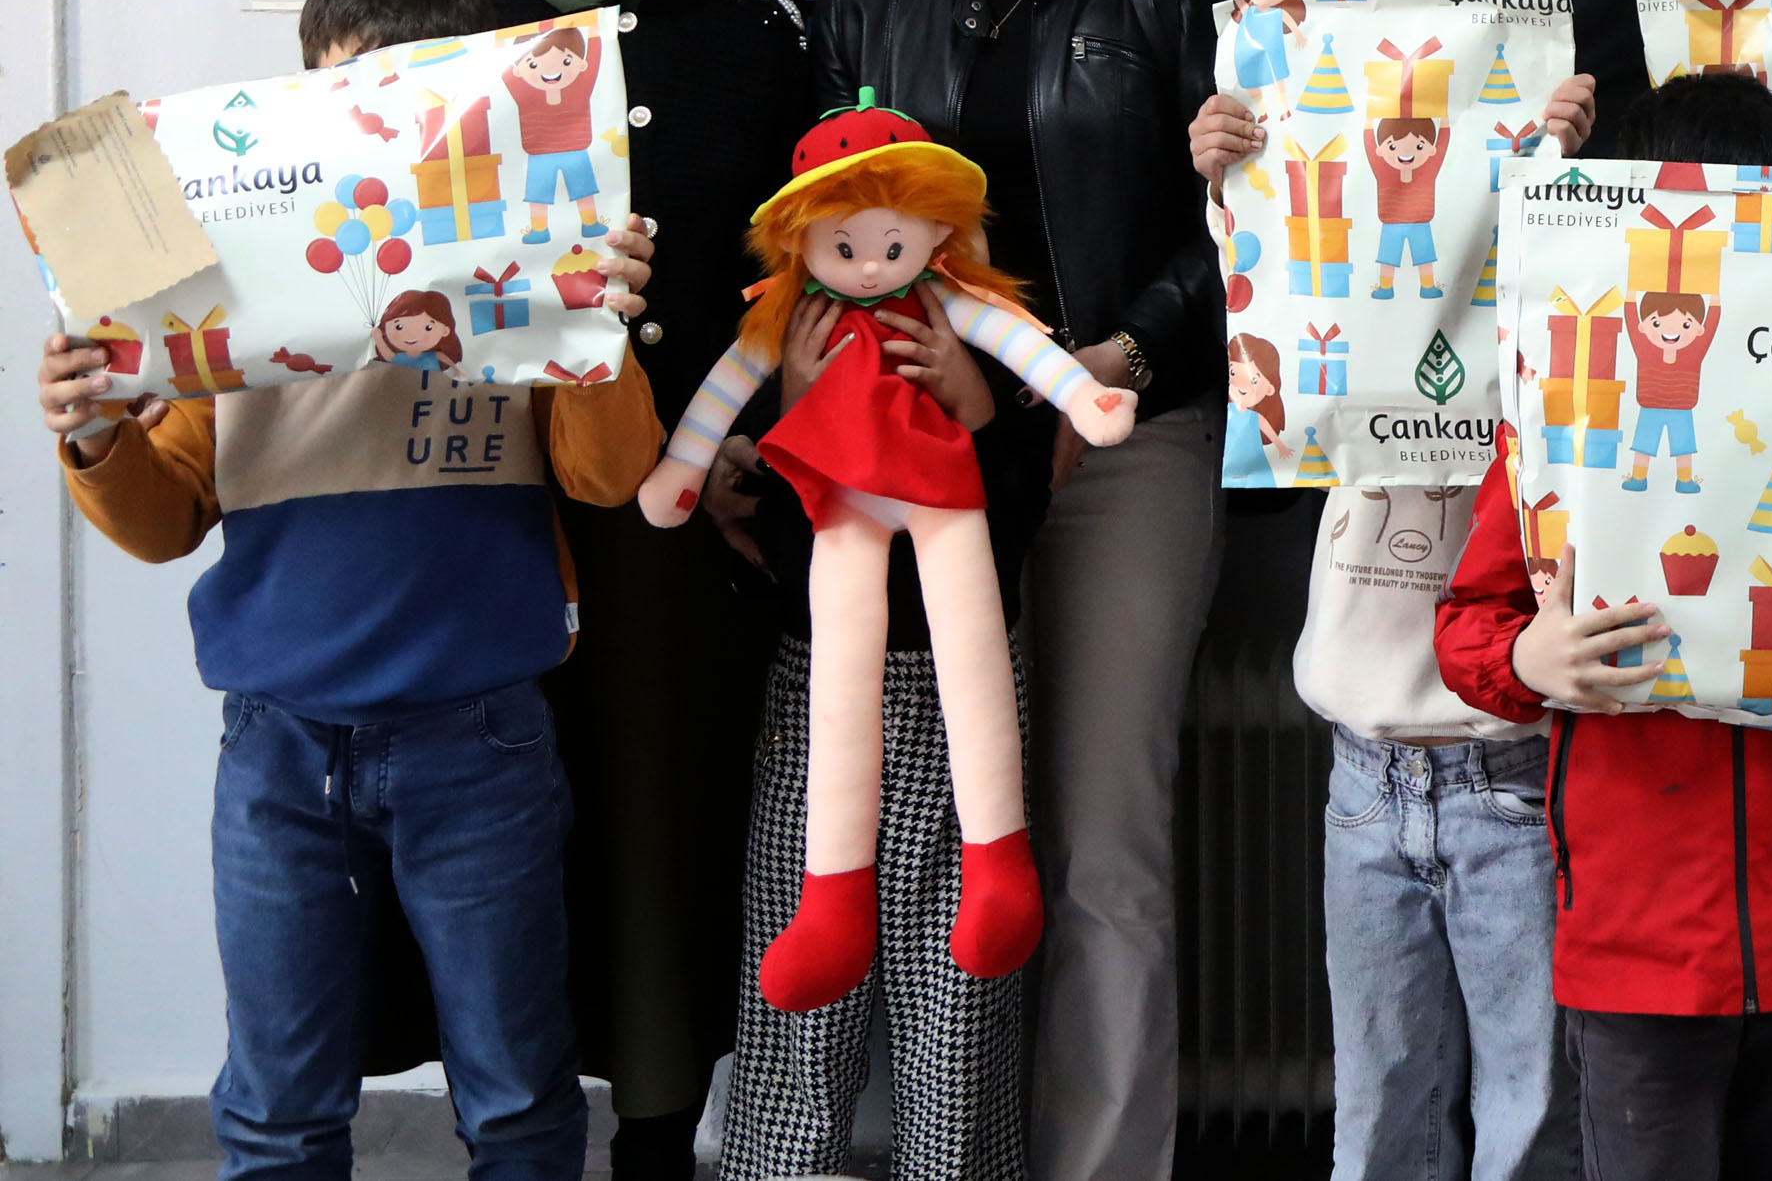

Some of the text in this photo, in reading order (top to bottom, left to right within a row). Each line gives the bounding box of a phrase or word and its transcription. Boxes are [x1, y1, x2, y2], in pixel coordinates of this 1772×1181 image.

[177, 161, 324, 201] ankaya
[1524, 184, 1645, 210] ankaya
[200, 197, 296, 227] ELEDİYESİ
[1527, 212, 1618, 228] BELEDİYESİ
[1369, 412, 1504, 446] Çankay
[1400, 448, 1492, 462] BELEDİYESİ
[1346, 565, 1372, 575] FUTURE
[1374, 567, 1403, 578] BELONGS
[1405, 570, 1414, 579] TO
[1359, 577, 1372, 586] THE
[1374, 578, 1398, 588] BEAUTY
[1400, 580, 1409, 590] OF
[1411, 582, 1431, 592] THEIR
